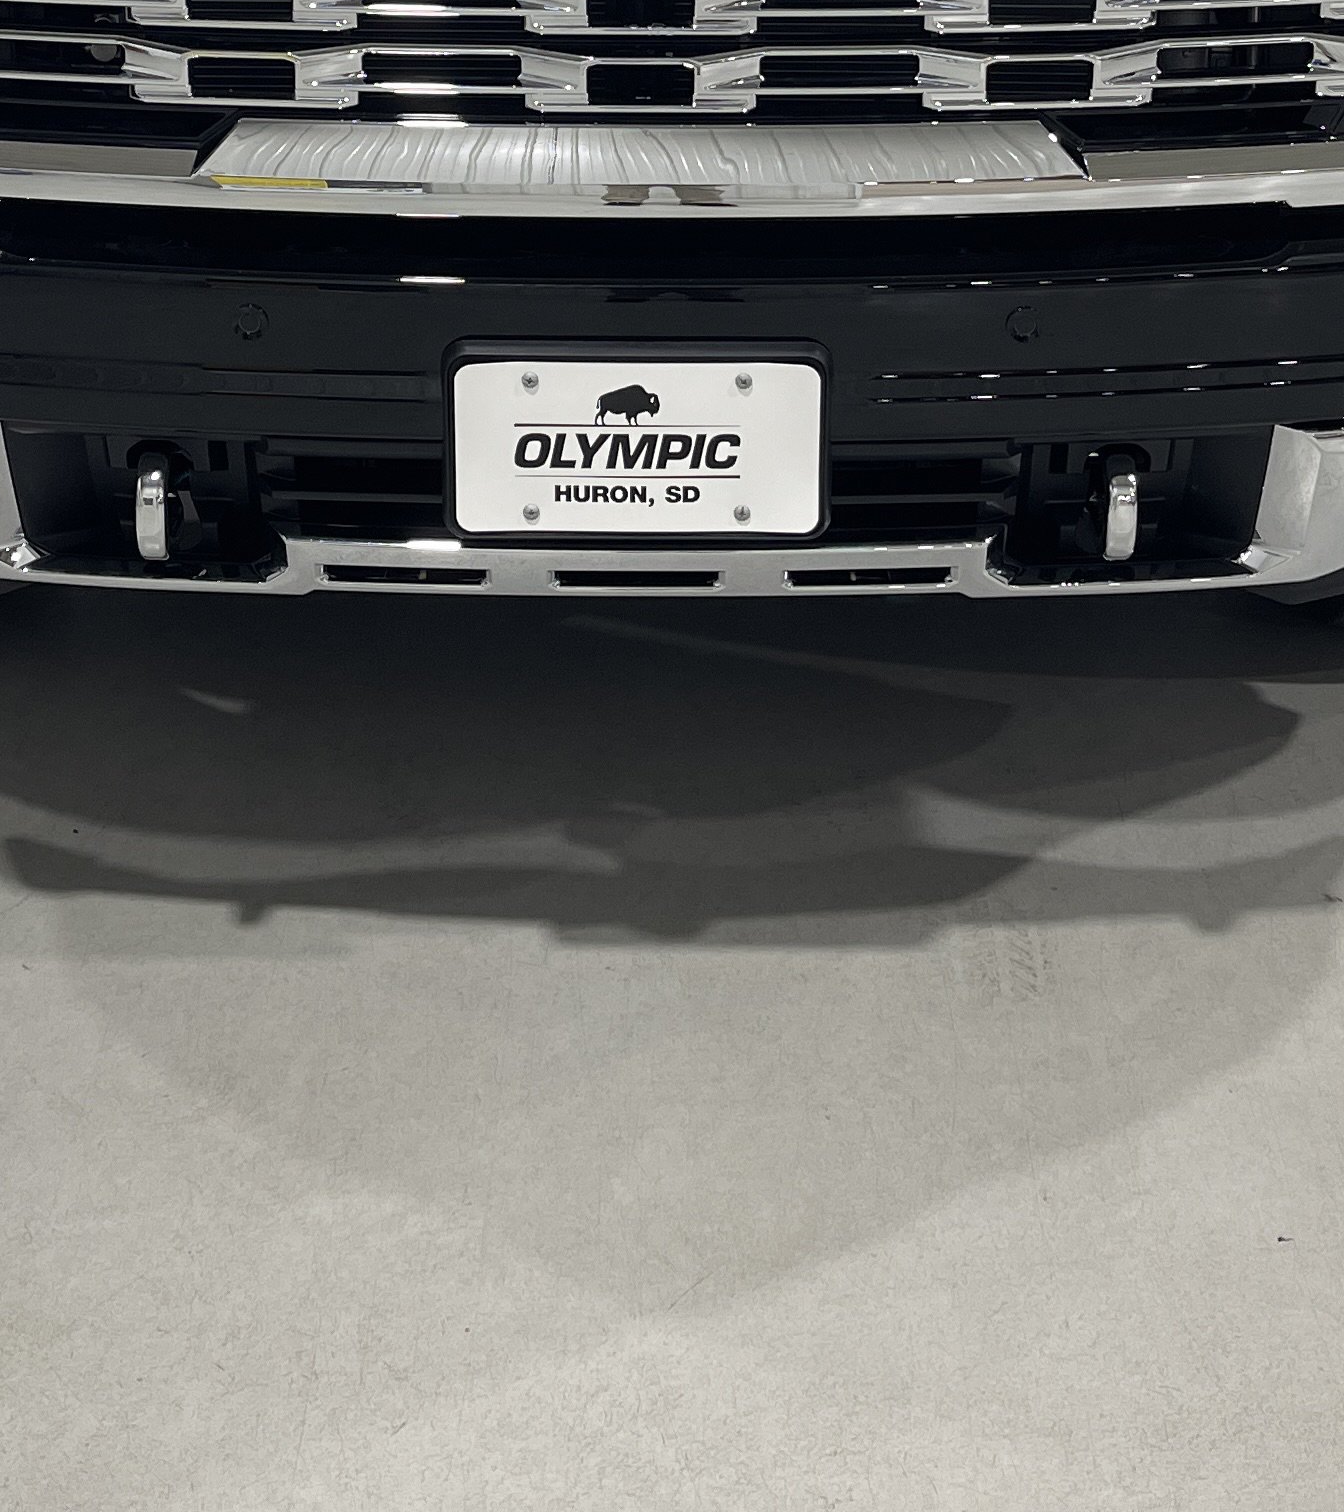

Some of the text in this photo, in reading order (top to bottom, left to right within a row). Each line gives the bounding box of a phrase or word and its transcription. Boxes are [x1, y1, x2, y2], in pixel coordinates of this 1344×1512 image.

[513, 432, 742, 470] OLYMPIC
[554, 484, 701, 507] HURON, SD
